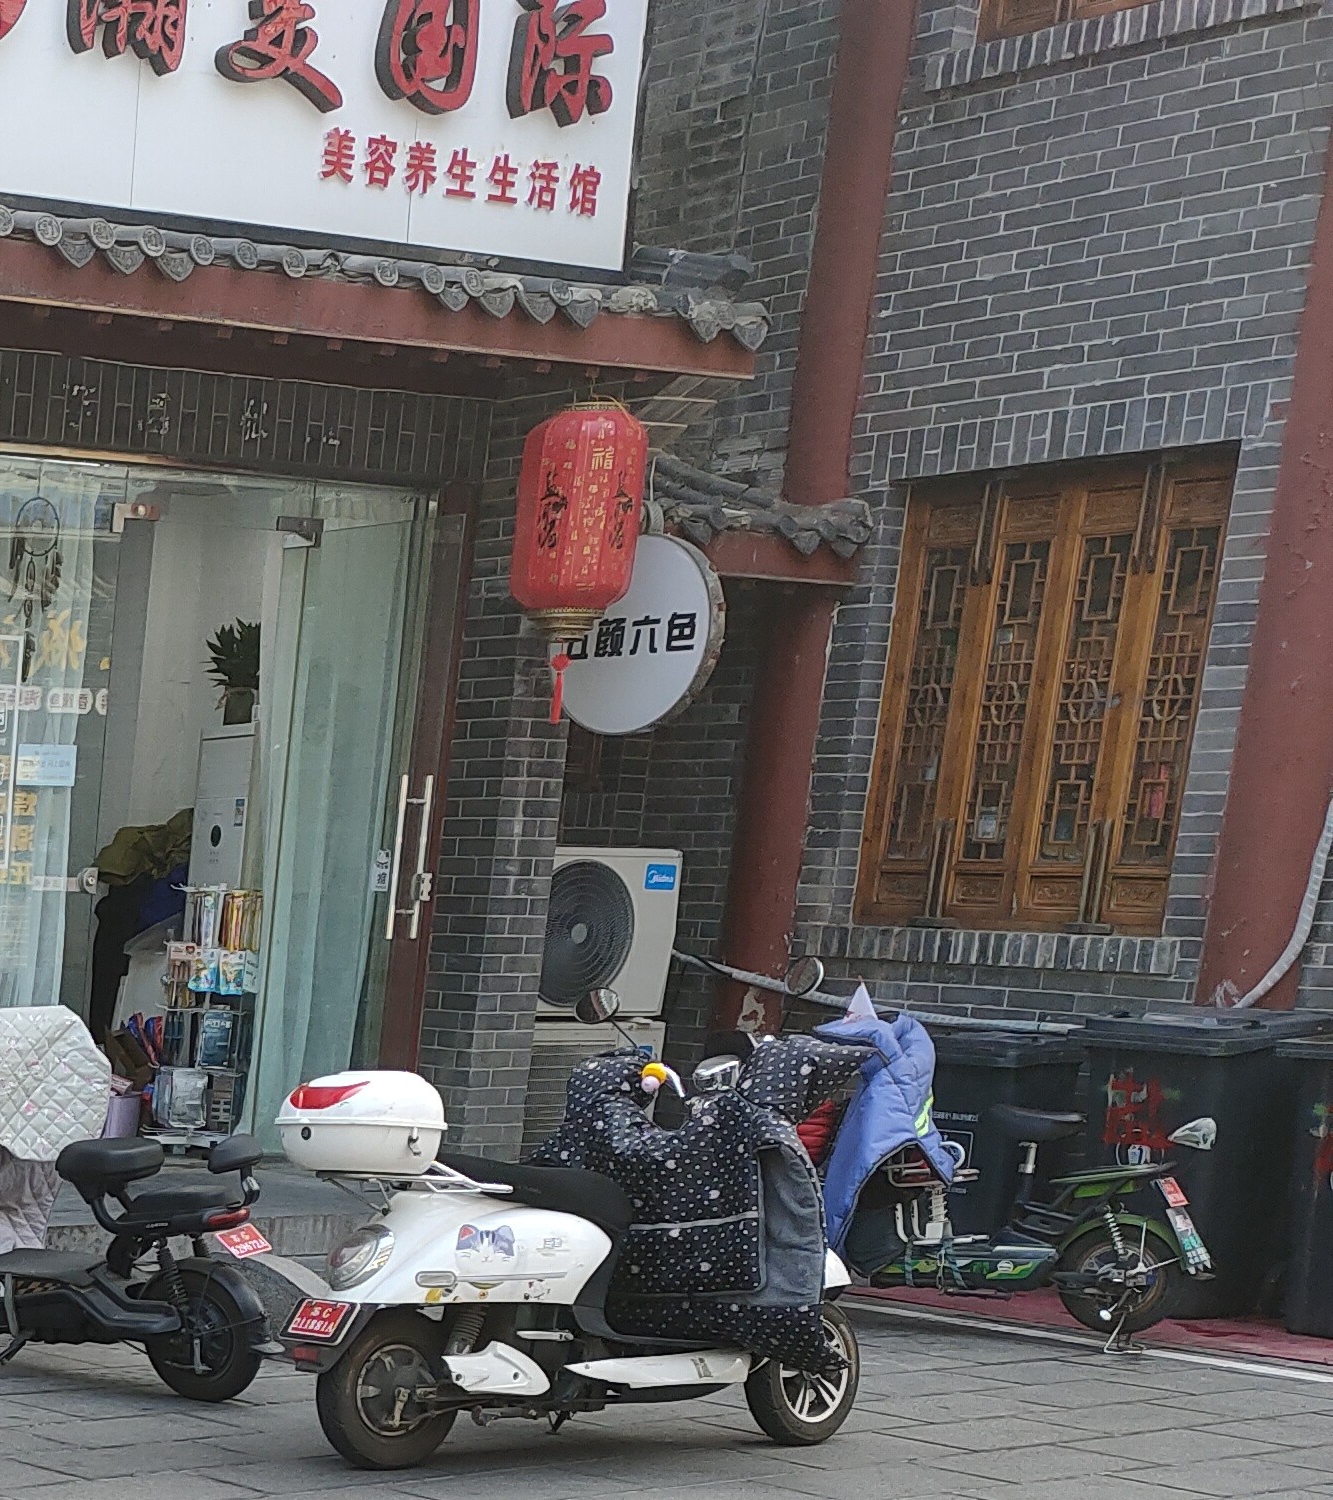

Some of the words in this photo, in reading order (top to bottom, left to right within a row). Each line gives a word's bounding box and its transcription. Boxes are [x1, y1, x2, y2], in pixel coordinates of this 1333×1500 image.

[320, 126, 604, 218] 美容养生生活馆
